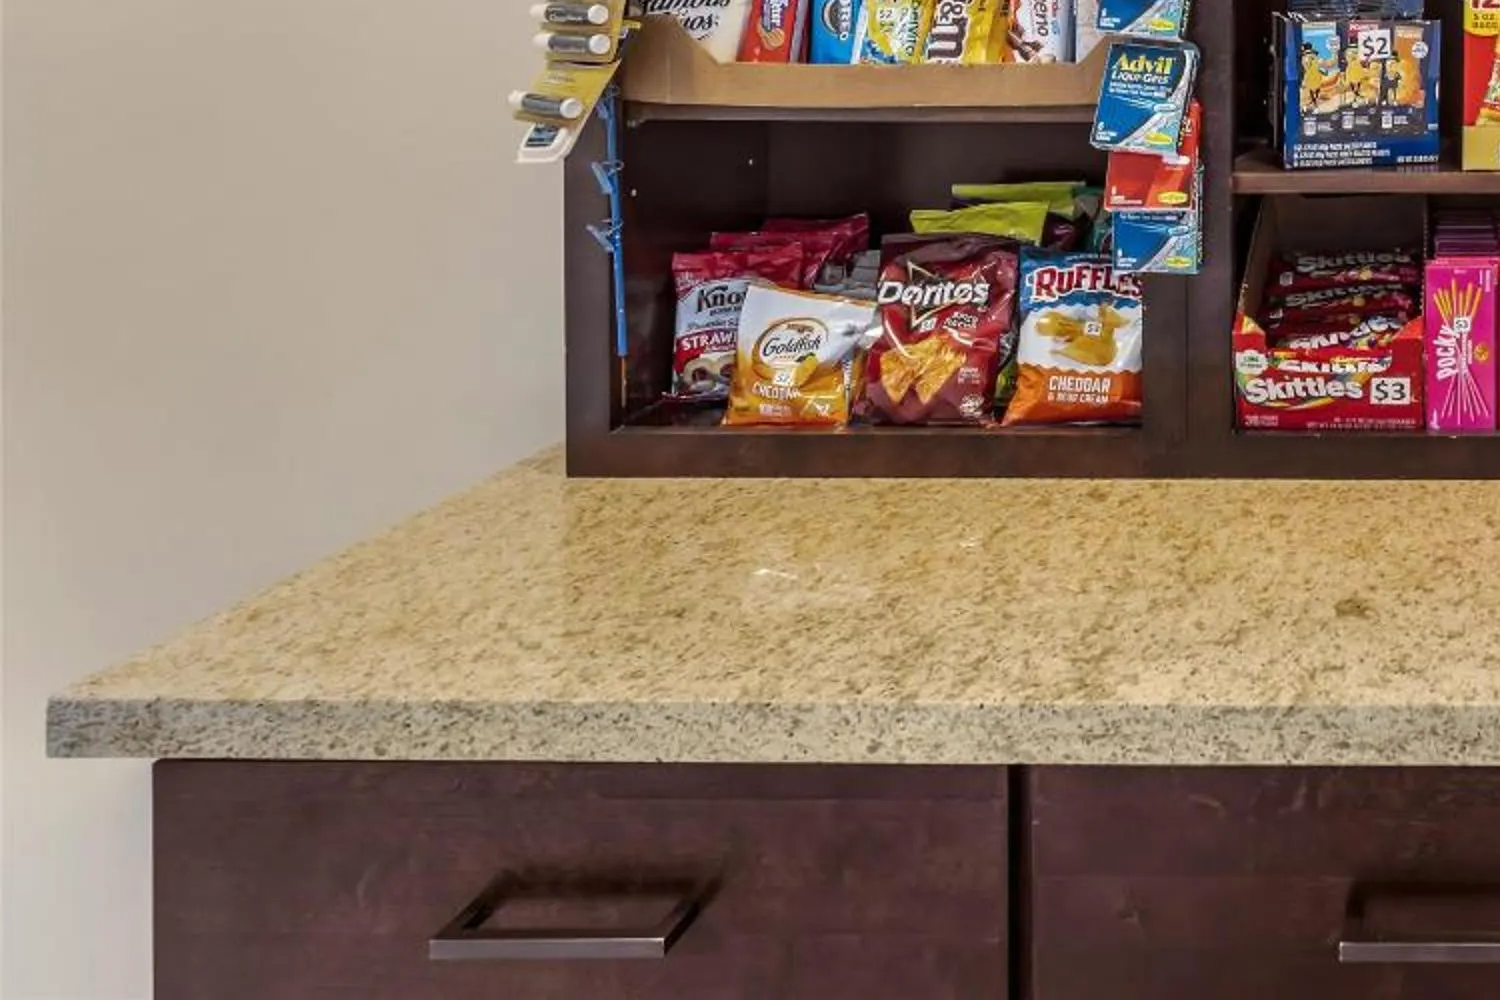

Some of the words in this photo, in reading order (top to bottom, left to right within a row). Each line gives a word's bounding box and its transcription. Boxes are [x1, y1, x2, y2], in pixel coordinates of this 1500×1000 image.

[1363, 35, 1388, 58] $2
[1116, 52, 1173, 75] Advil
[877, 280, 990, 307] Doritos
[1033, 265, 1143, 299] RUFFLES
[681, 329, 737, 351] STRAW
[762, 333, 822, 357] Goldfish
[1049, 375, 1111, 393] CHEDDAR
[1246, 375, 1364, 403] Skittles
[1374, 380, 1406, 401] $3
